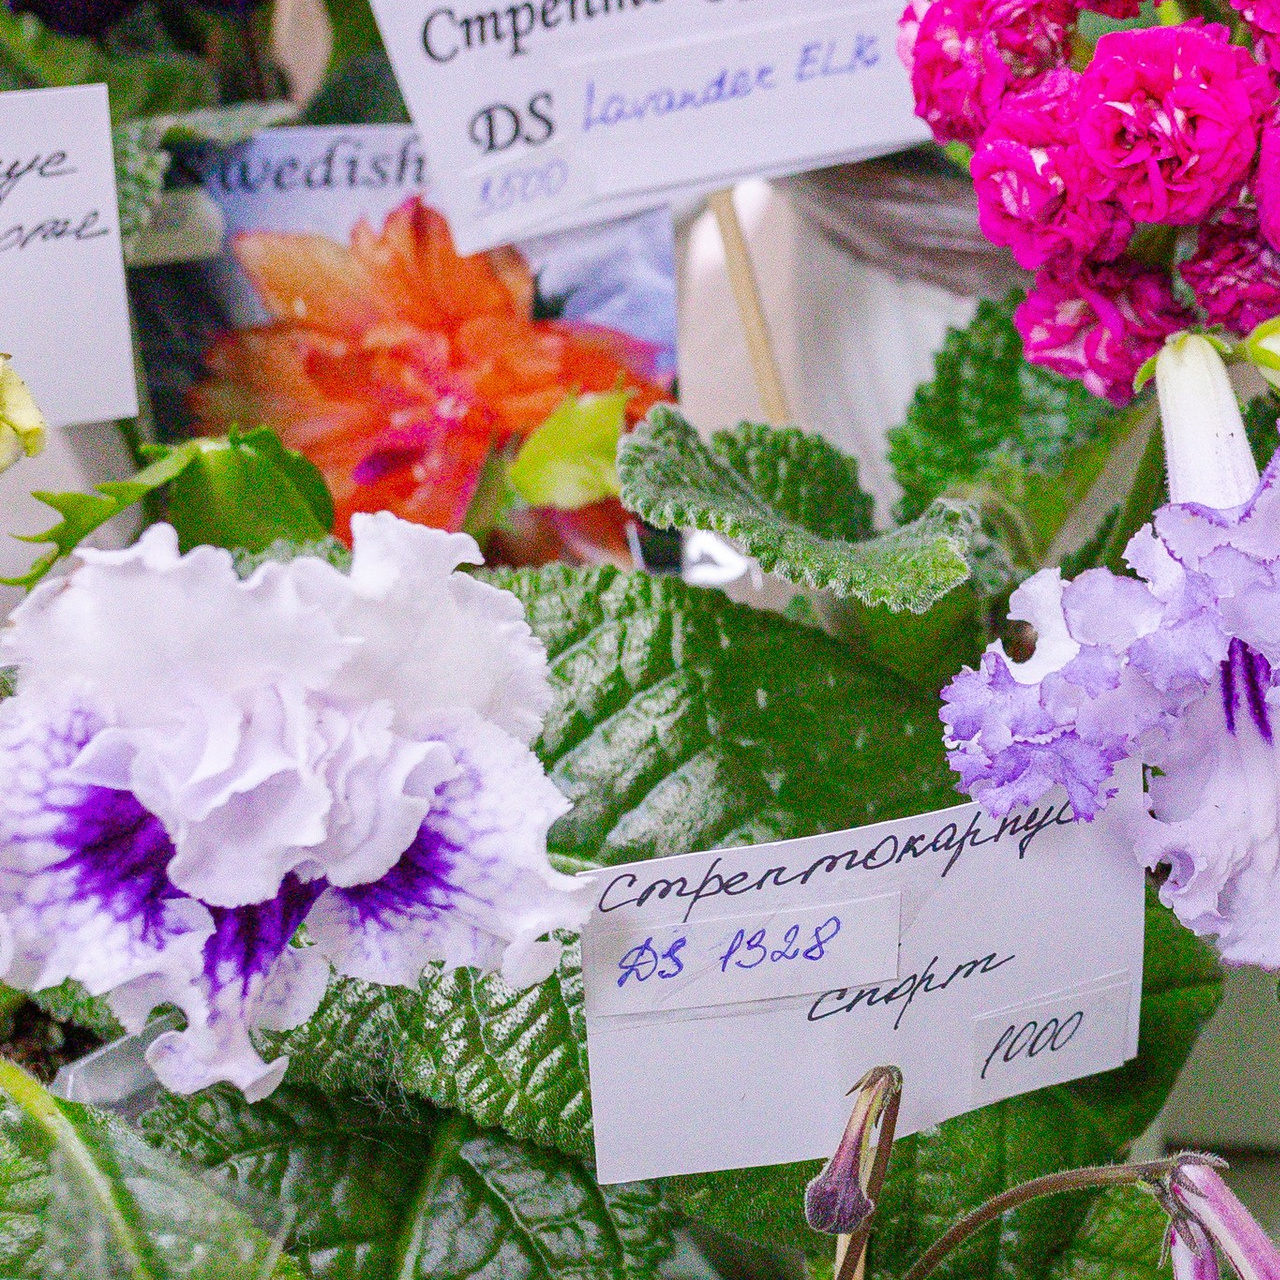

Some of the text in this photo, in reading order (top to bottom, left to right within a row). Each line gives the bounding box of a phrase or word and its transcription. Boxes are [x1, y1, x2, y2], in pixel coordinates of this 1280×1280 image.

[469, 91, 556, 154] DS
[808, 952, 1015, 1029] спорт
[980, 1011, 1085, 1080] 1000
